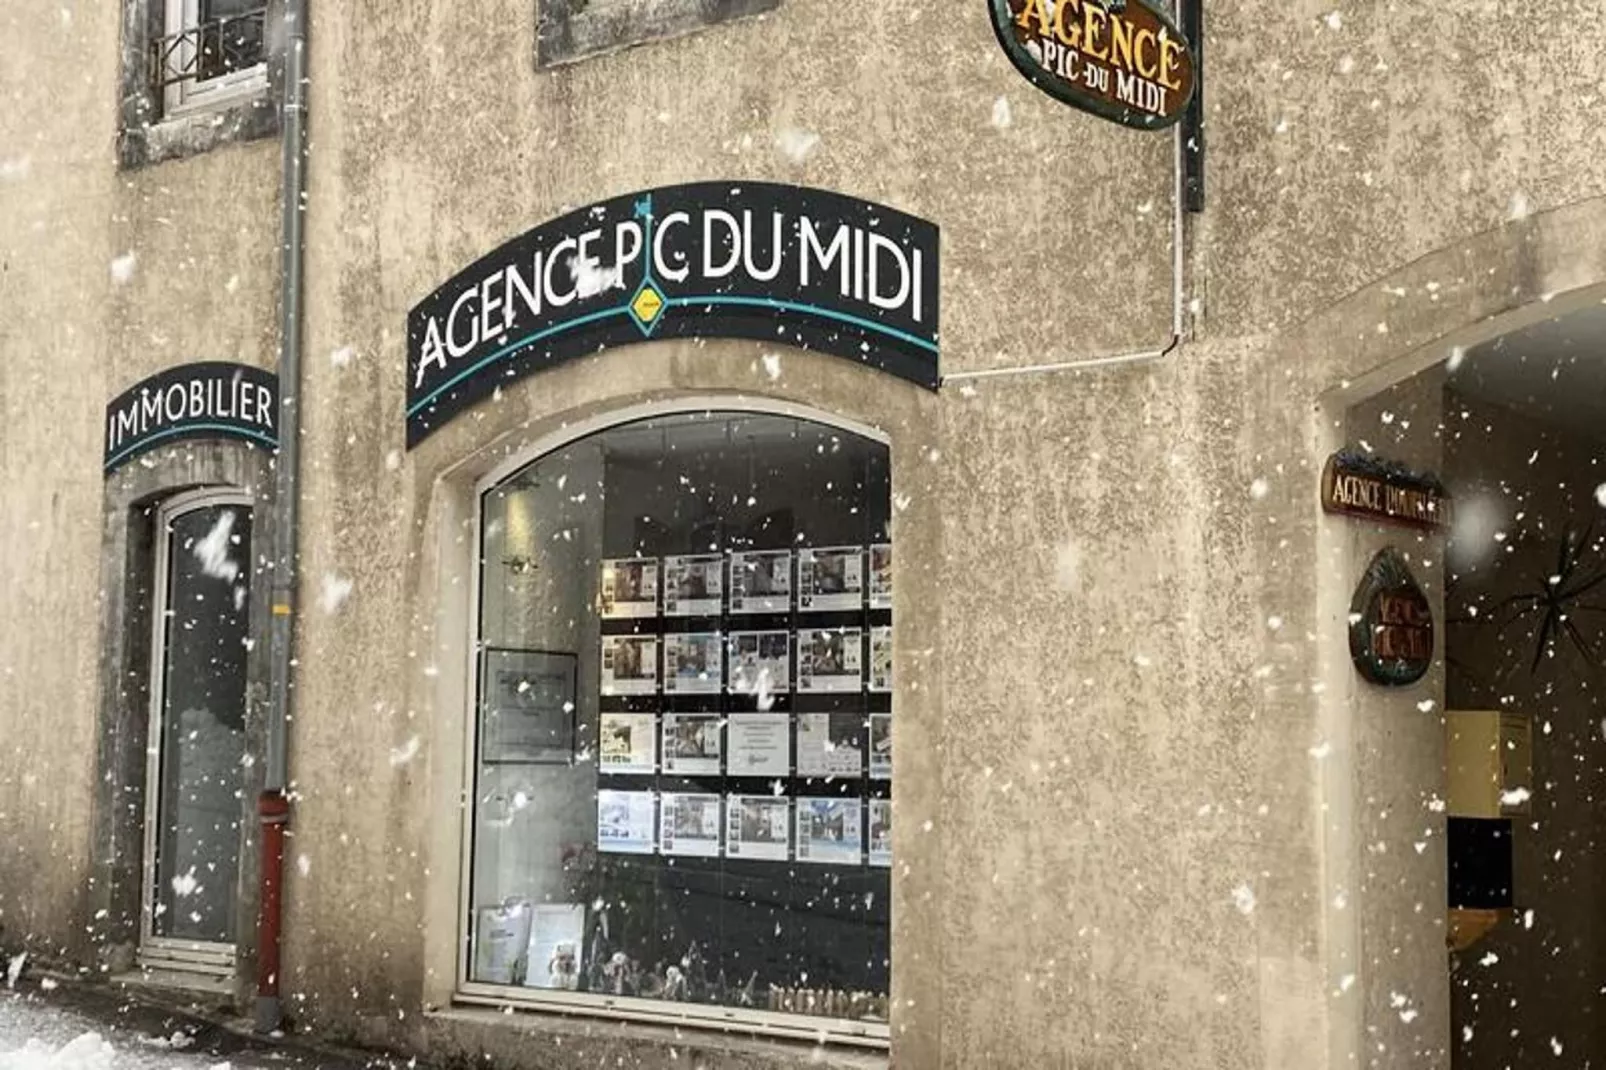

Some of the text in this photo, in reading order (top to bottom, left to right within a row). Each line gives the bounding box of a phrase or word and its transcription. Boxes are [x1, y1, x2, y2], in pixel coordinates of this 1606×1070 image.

[1017, 0, 1183, 90] AGENCE
[1042, 38, 1168, 117] PIC DU MIDI
[416, 229, 602, 388] AGENCE
[703, 210, 782, 281] DU
[800, 216, 923, 322] MIDI
[109, 378, 273, 451] IMMOBILIER
[1333, 475, 1381, 510] AGENCE
